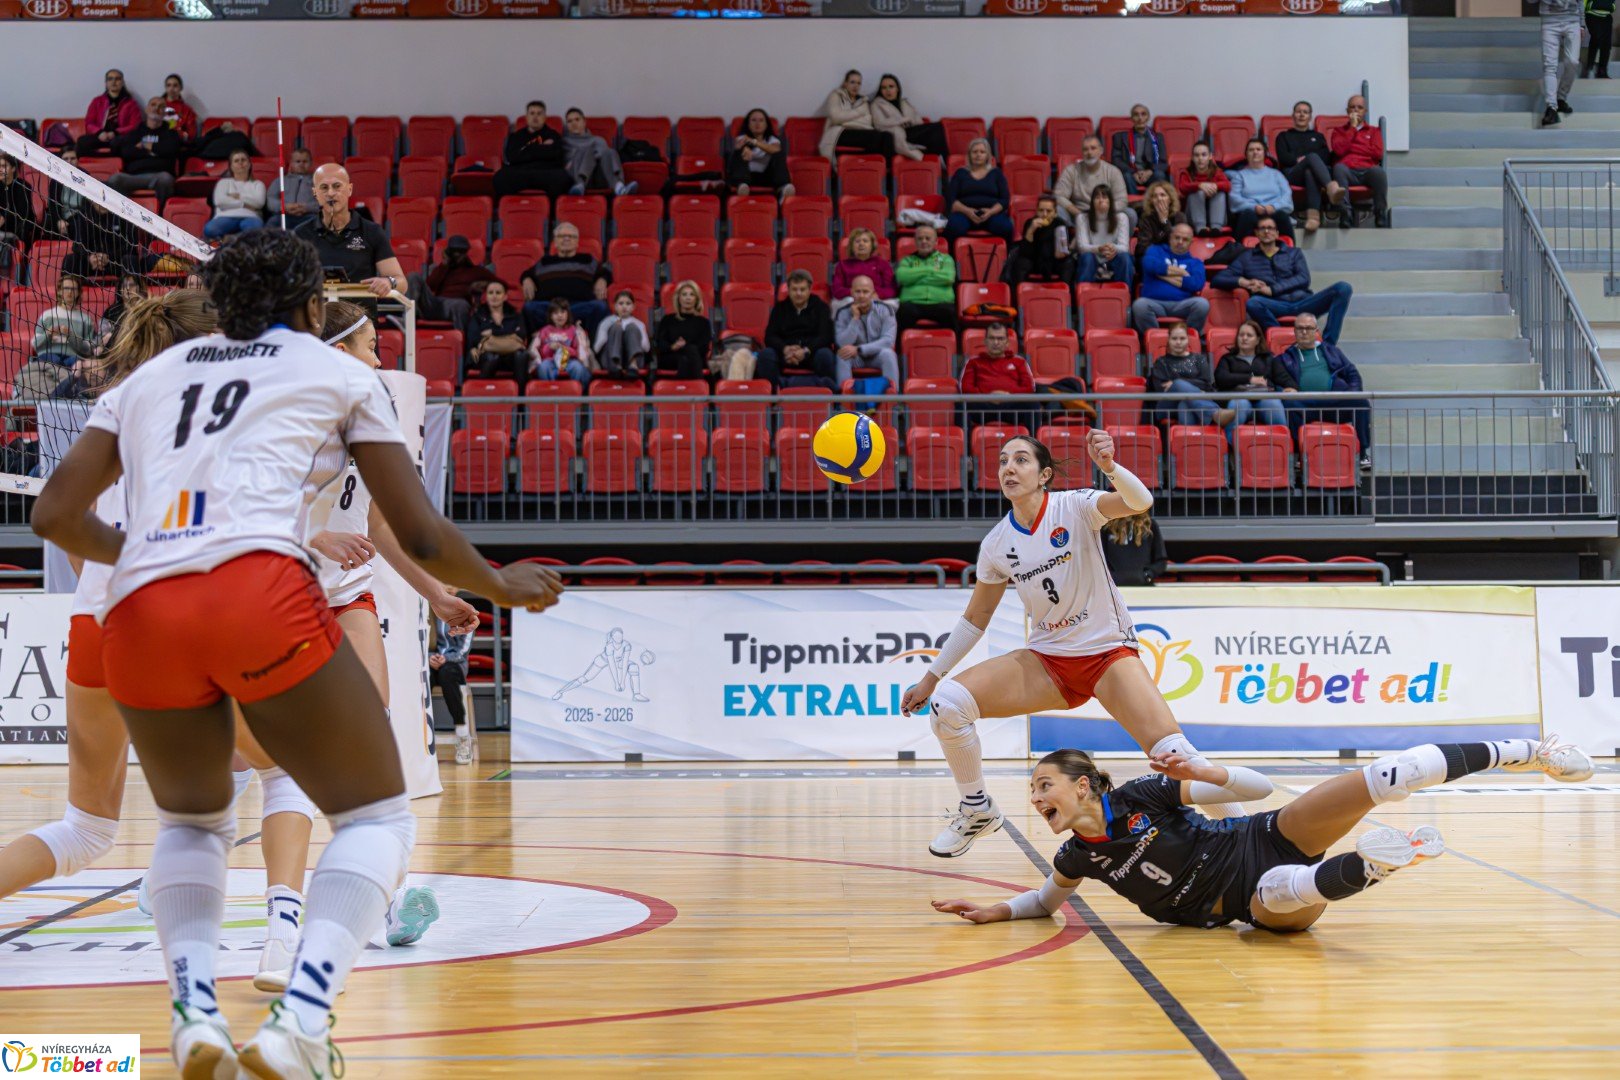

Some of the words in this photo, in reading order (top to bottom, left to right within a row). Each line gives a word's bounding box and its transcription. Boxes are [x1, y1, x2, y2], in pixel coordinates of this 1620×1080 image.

[173, 379, 250, 449] 19
[340, 474, 356, 510] 8
[1014, 551, 1072, 583] TippmixPRO
[1042, 577, 1060, 604] 3
[1215, 631, 1391, 656] NYÍREGYHÁZA
[1215, 662, 1370, 704] Többet
[1379, 662, 1453, 704] ad!
[565, 707, 594, 722] 2025
[604, 707, 634, 722] 2026
[1109, 826, 1159, 882] TippmixPRO
[1140, 861, 1173, 886] 9
